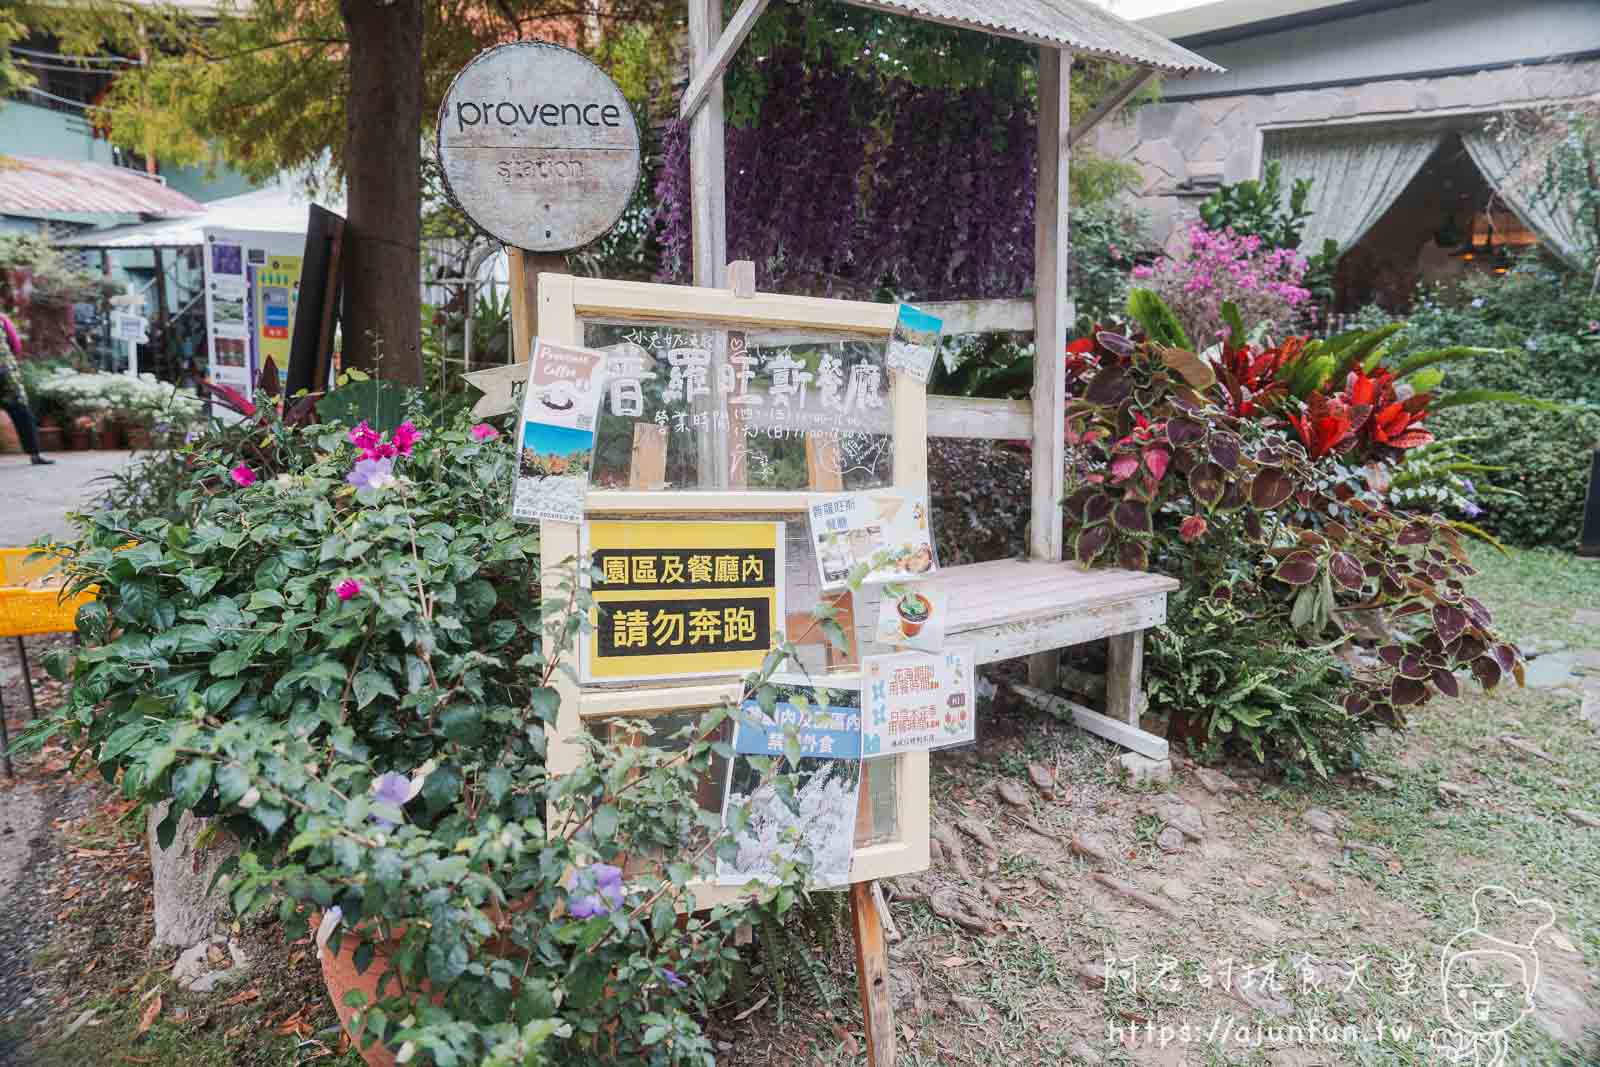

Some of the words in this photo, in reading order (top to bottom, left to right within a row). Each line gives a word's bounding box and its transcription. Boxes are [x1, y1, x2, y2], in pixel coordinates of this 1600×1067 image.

[456, 101, 620, 133] provence
[497, 159, 585, 179] station
[602, 554, 765, 585] 園區及餐廳內
[612, 606, 757, 648] 請勿奔跑
